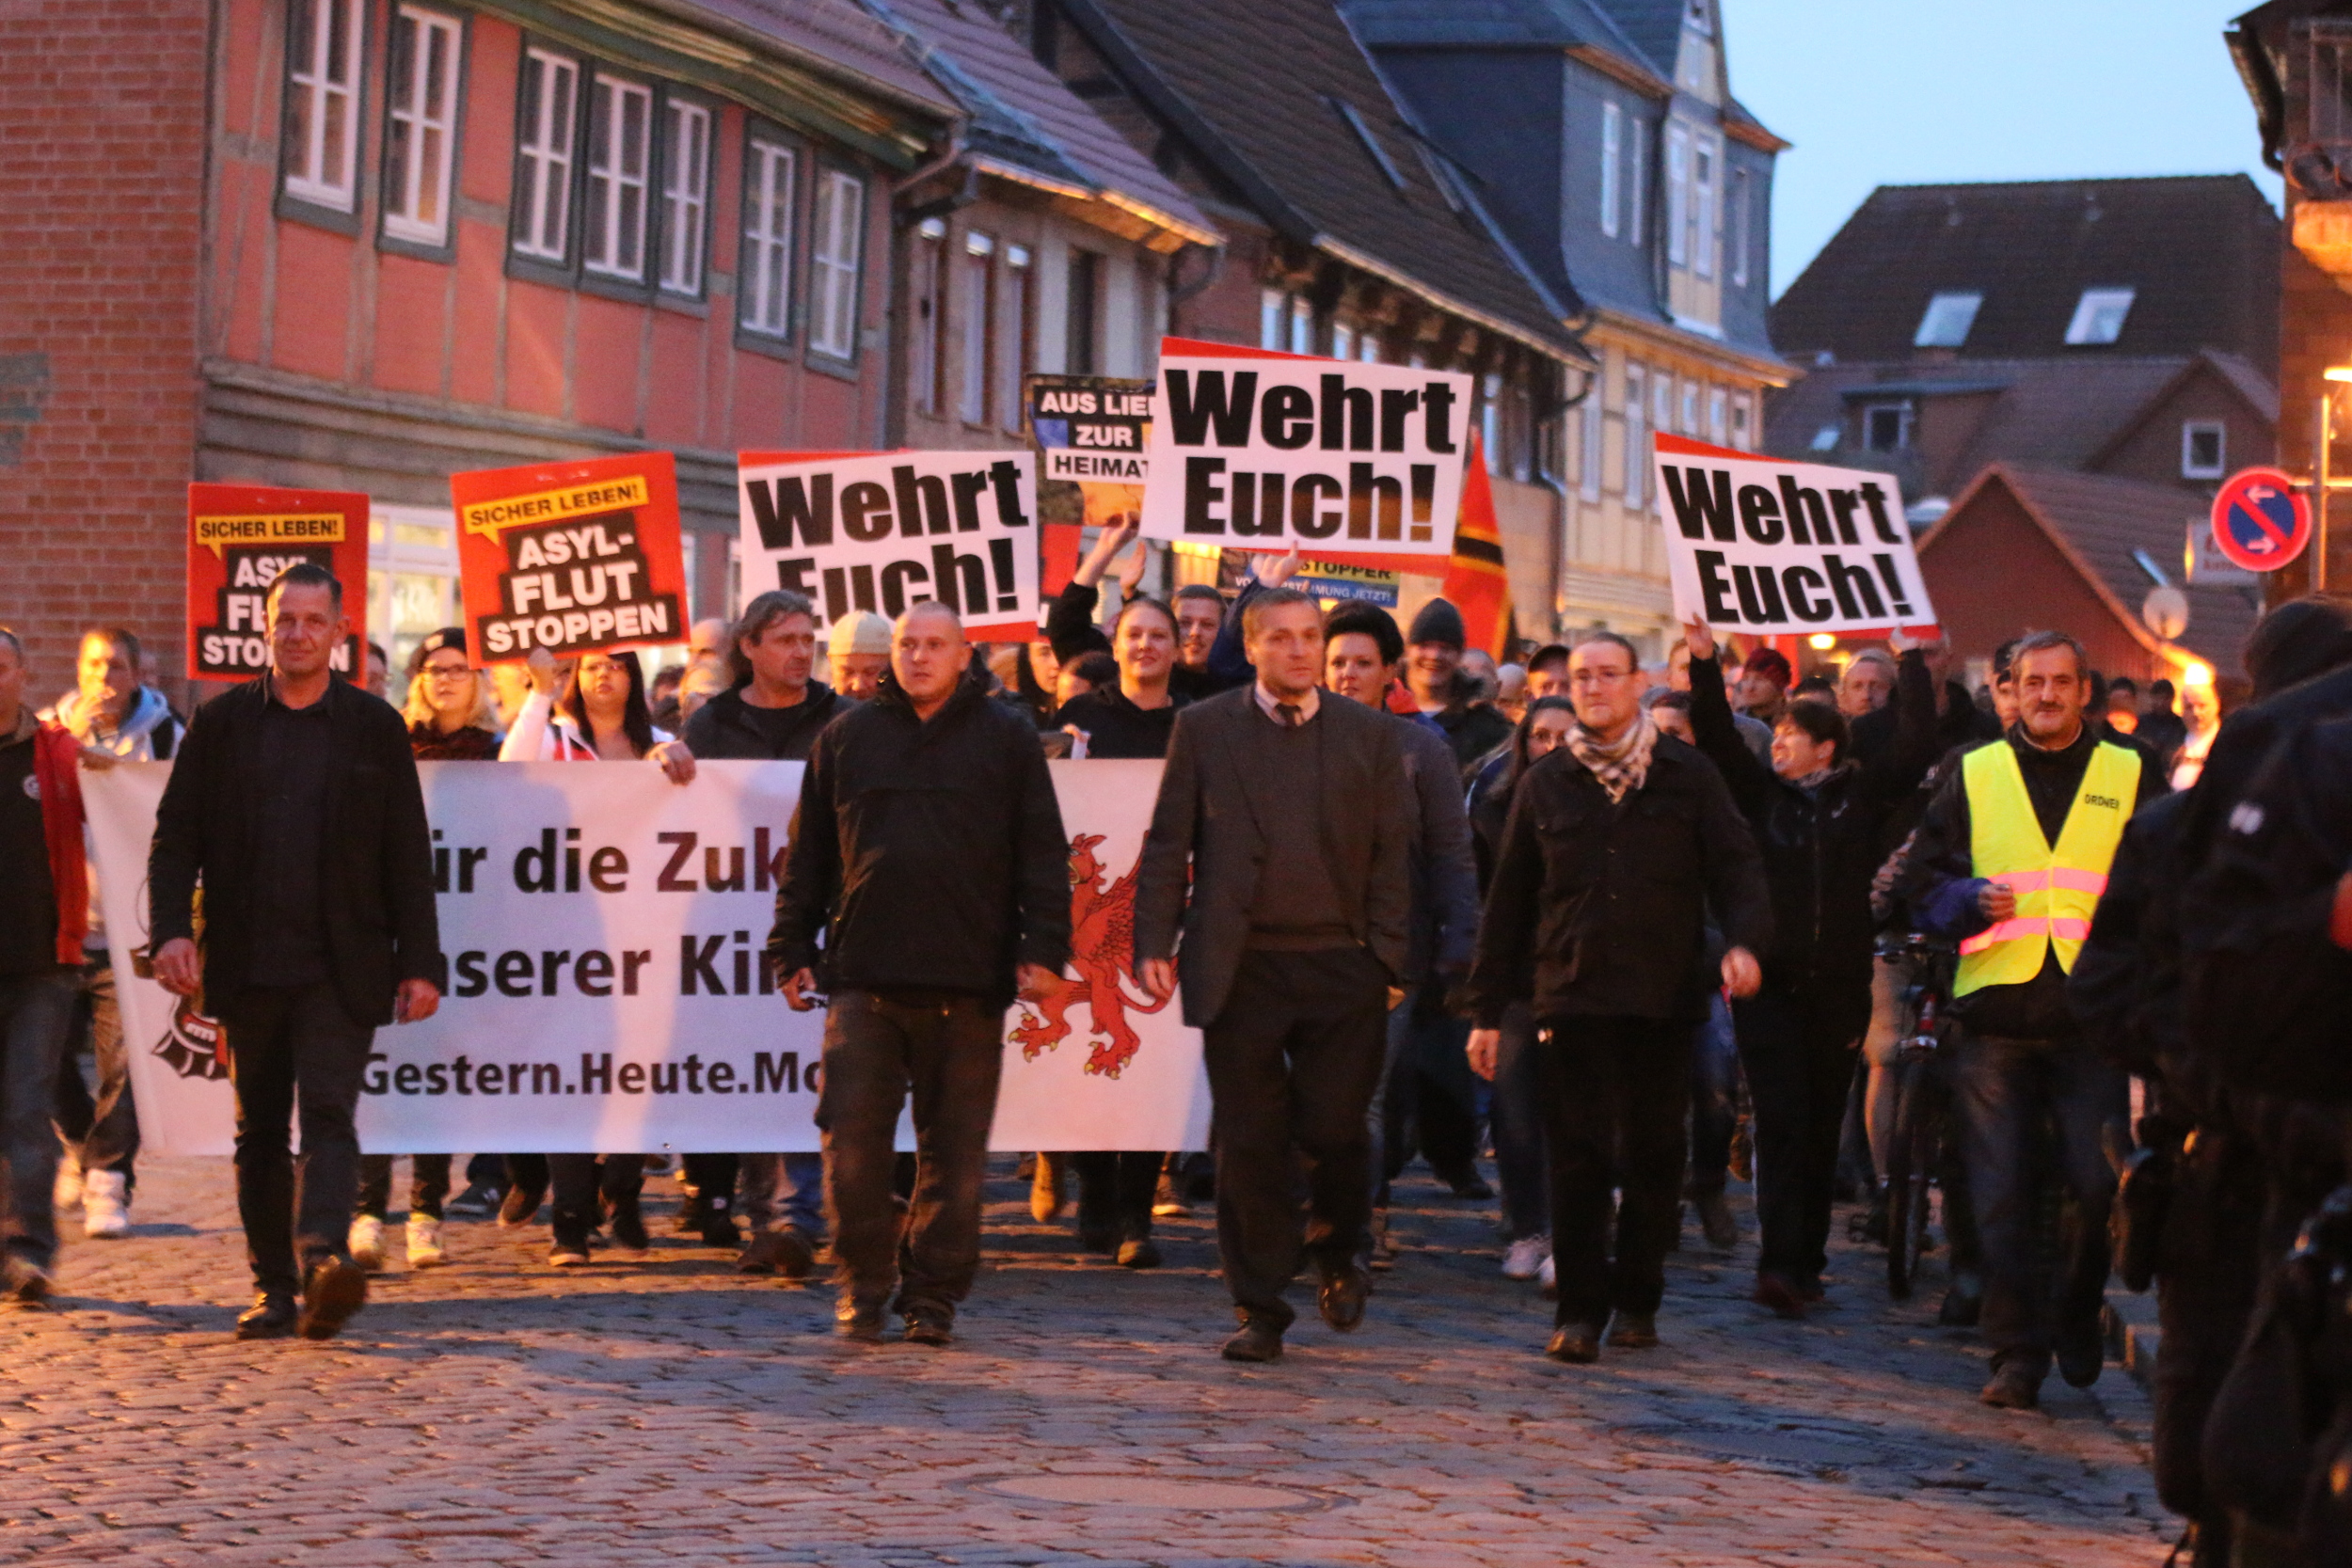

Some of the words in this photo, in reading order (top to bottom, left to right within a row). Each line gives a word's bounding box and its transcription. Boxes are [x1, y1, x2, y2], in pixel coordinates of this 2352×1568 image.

[1041, 391, 1097, 414] AUS
[1164, 369, 1456, 455] Wehrt
[1075, 424, 1133, 447] ZUR
[199, 521, 266, 538] SICHER
[273, 520, 338, 536] LEBEN!
[470, 499, 552, 527] SICHER
[560, 483, 639, 510] LEBEN!
[745, 460, 1030, 549] Wehrt
[1184, 456, 1437, 543] Euch!
[1661, 465, 1902, 546] Wehrt
[517, 524, 634, 570] ASYL-
[511, 561, 639, 614] FLUT
[777, 537, 1019, 629] Euch!
[1694, 549, 1915, 625] Euch!
[486, 602, 669, 653] STOPPEN
[514, 828, 628, 893] die
